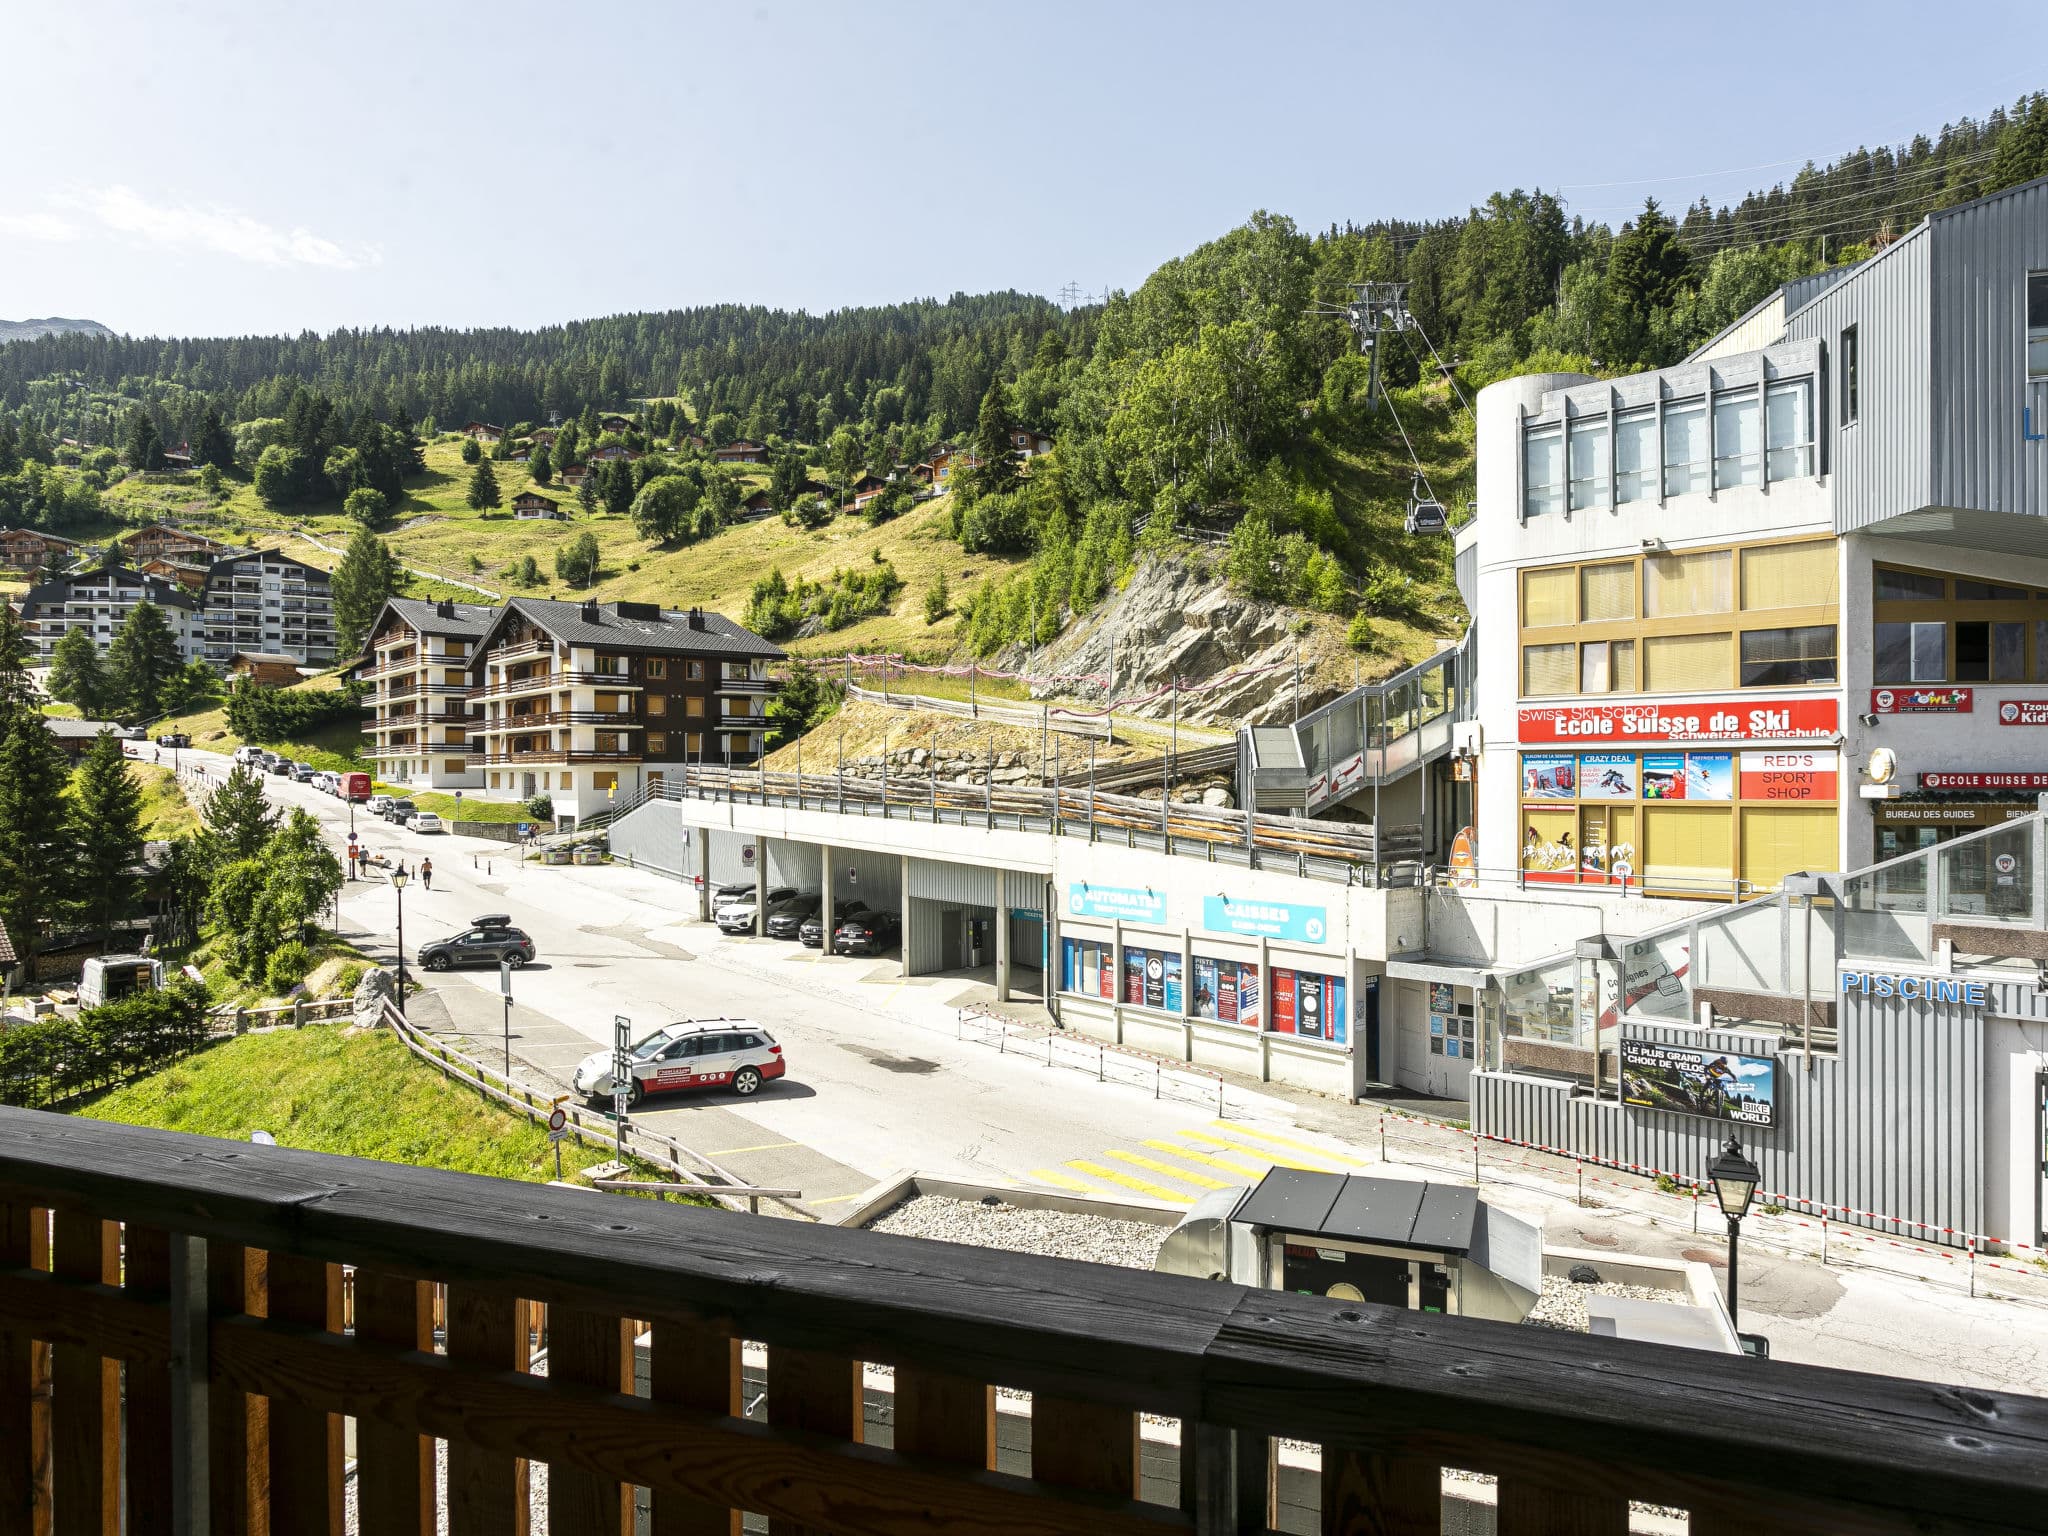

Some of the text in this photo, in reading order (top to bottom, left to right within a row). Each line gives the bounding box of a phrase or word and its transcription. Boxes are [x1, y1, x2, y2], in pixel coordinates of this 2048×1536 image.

[1519, 705, 1659, 722] Swiss Ski School
[1555, 709, 1790, 736] Ecole Suisse de Ski
[1668, 727, 1831, 740] Schweizer Skischule
[1764, 755, 1813, 767] RED'S
[1762, 772, 1816, 784] SPORT
[1942, 775, 1979, 785] ECOLE
[1985, 775, 2027, 785] SUISSE
[1767, 787, 1811, 799] SHOP
[1886, 811, 1921, 819] BUREAU
[1924, 811, 1941, 819] DES
[1943, 811, 1976, 819] GUIDES
[1841, 971, 1986, 1006] PISCINE
[1628, 1046, 1702, 1064] LE PLUS GRAND
[1627, 1055, 1706, 1074] CHOIX DE VÉLOS
[1743, 1103, 1769, 1114] BIKE
[1730, 1110, 1771, 1124] WORLD
